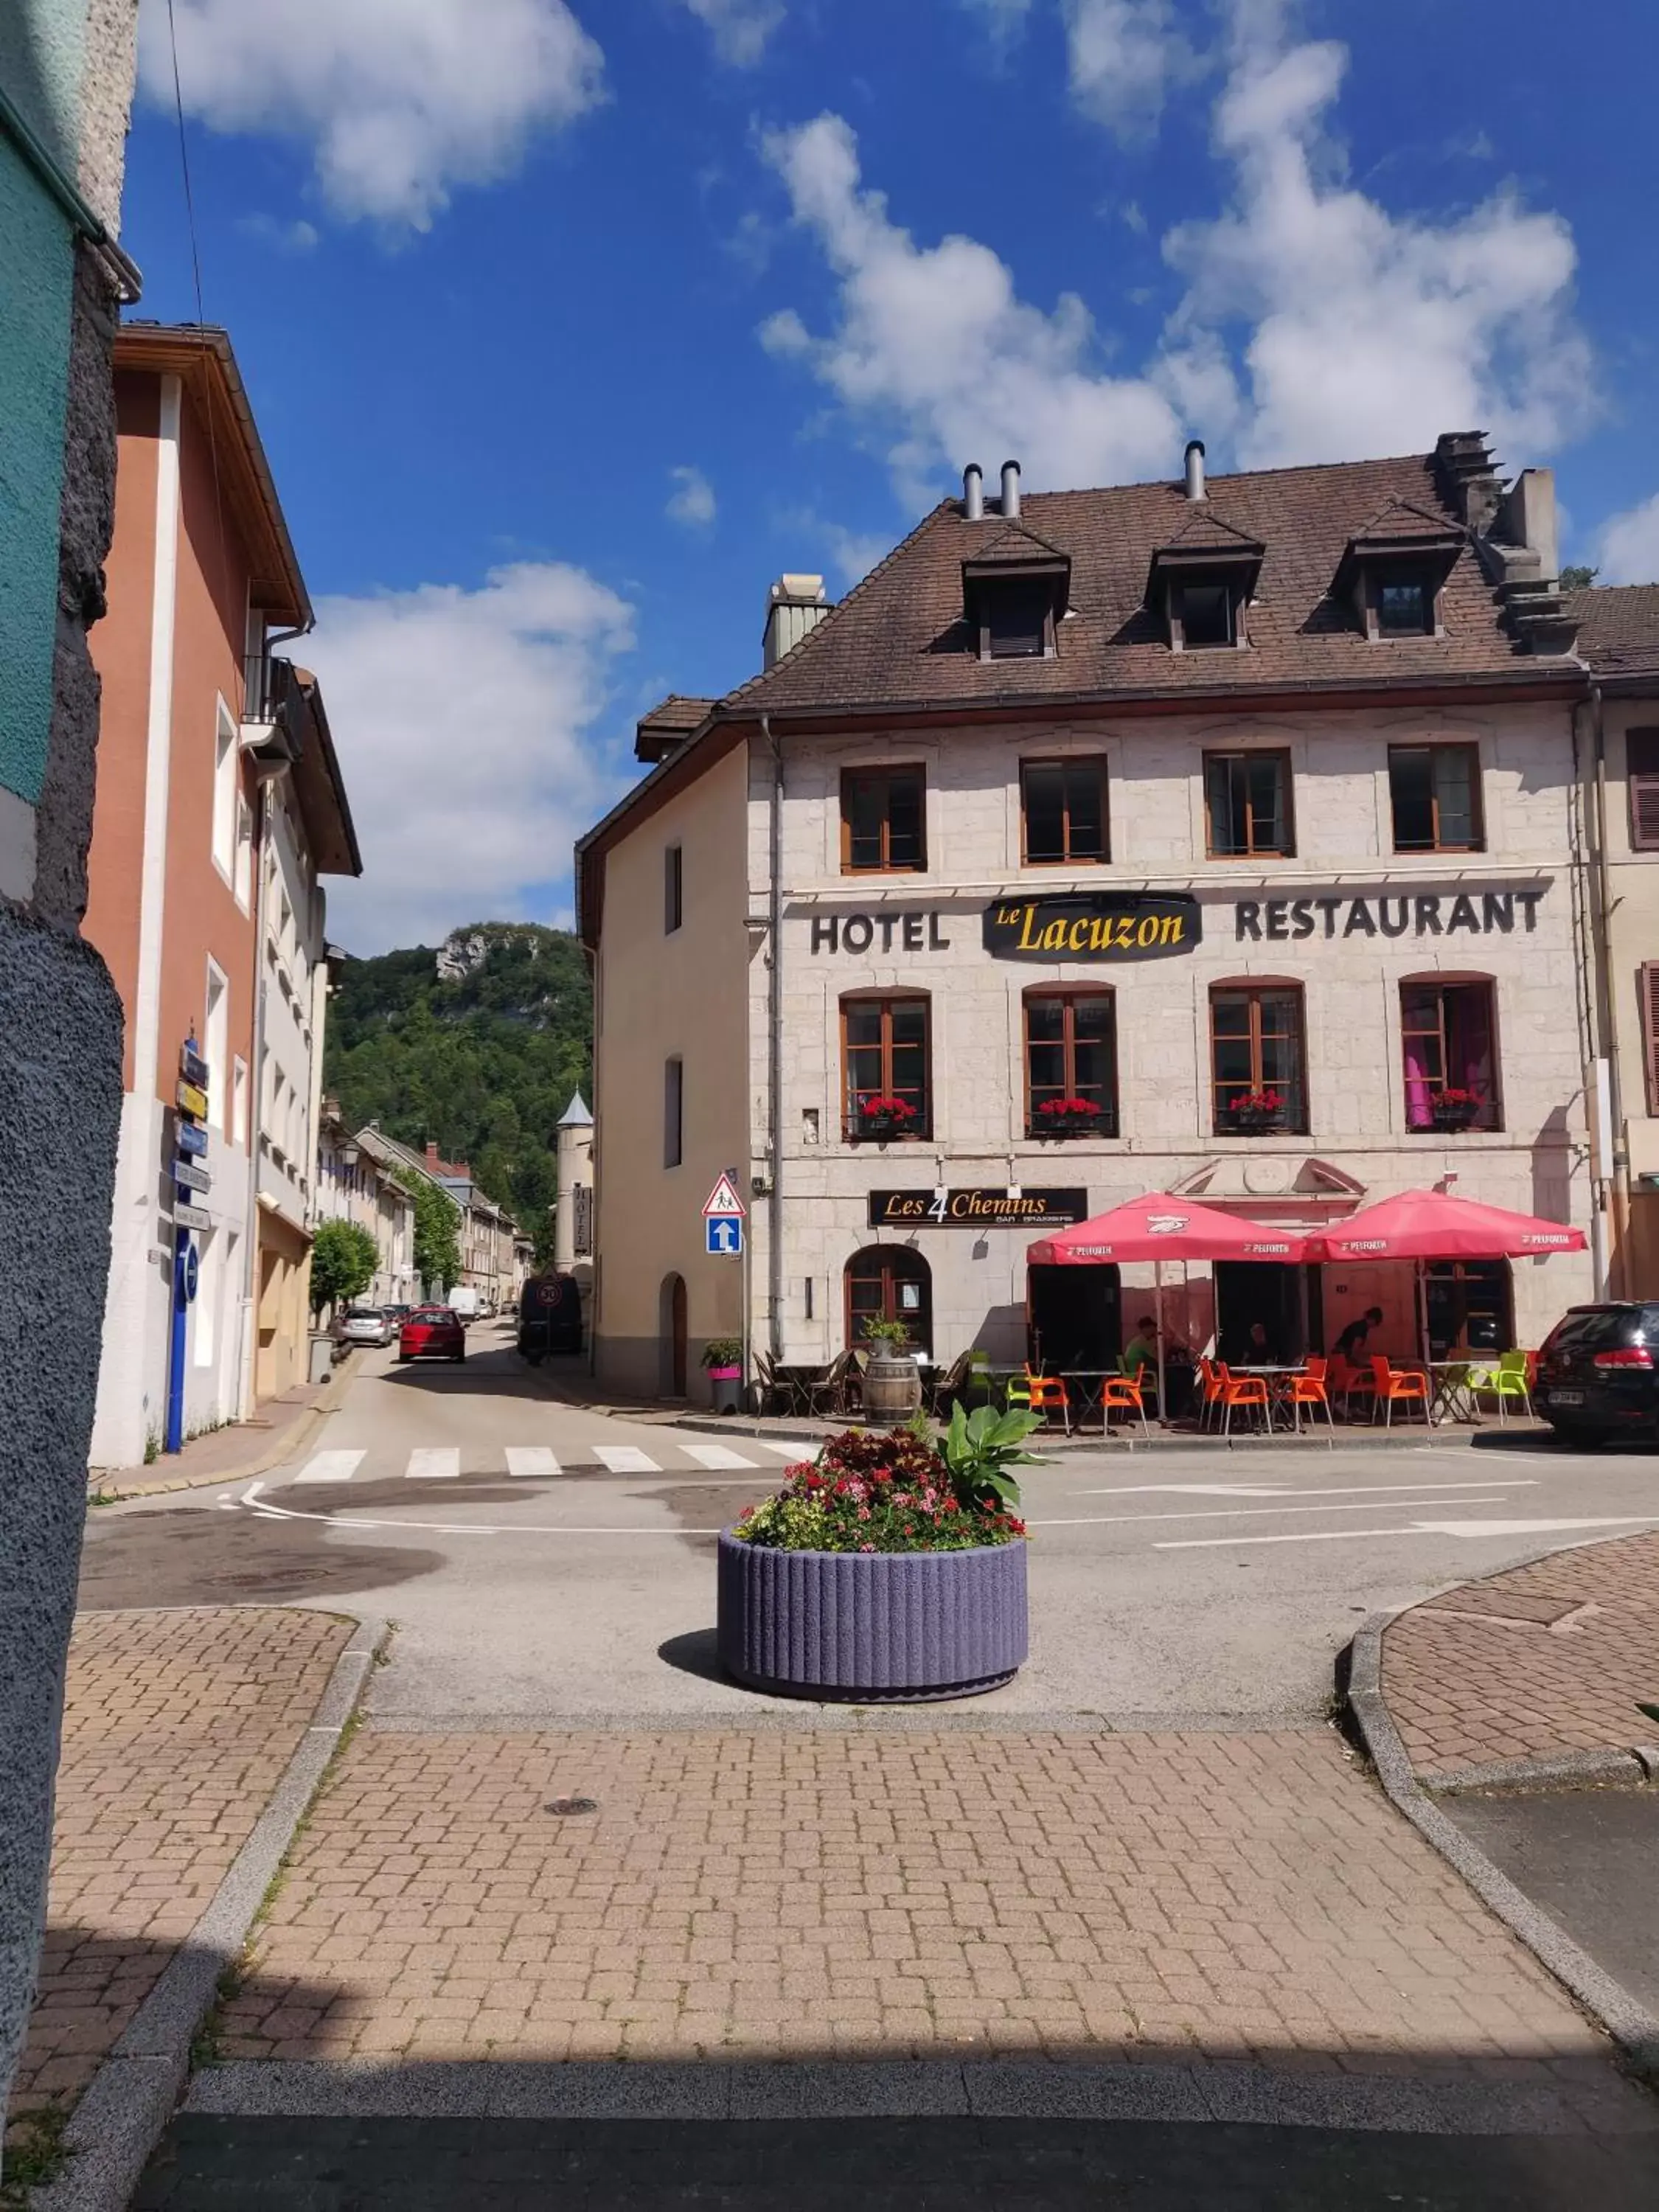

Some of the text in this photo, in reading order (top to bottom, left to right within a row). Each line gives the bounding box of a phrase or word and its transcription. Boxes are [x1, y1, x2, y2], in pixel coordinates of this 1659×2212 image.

[811, 911, 950, 954] HOTEL
[995, 903, 1185, 952] Le Lacuzon
[1235, 891, 1546, 942] RESTAURANT
[886, 1192, 1046, 1222] Les 4 Chemins
